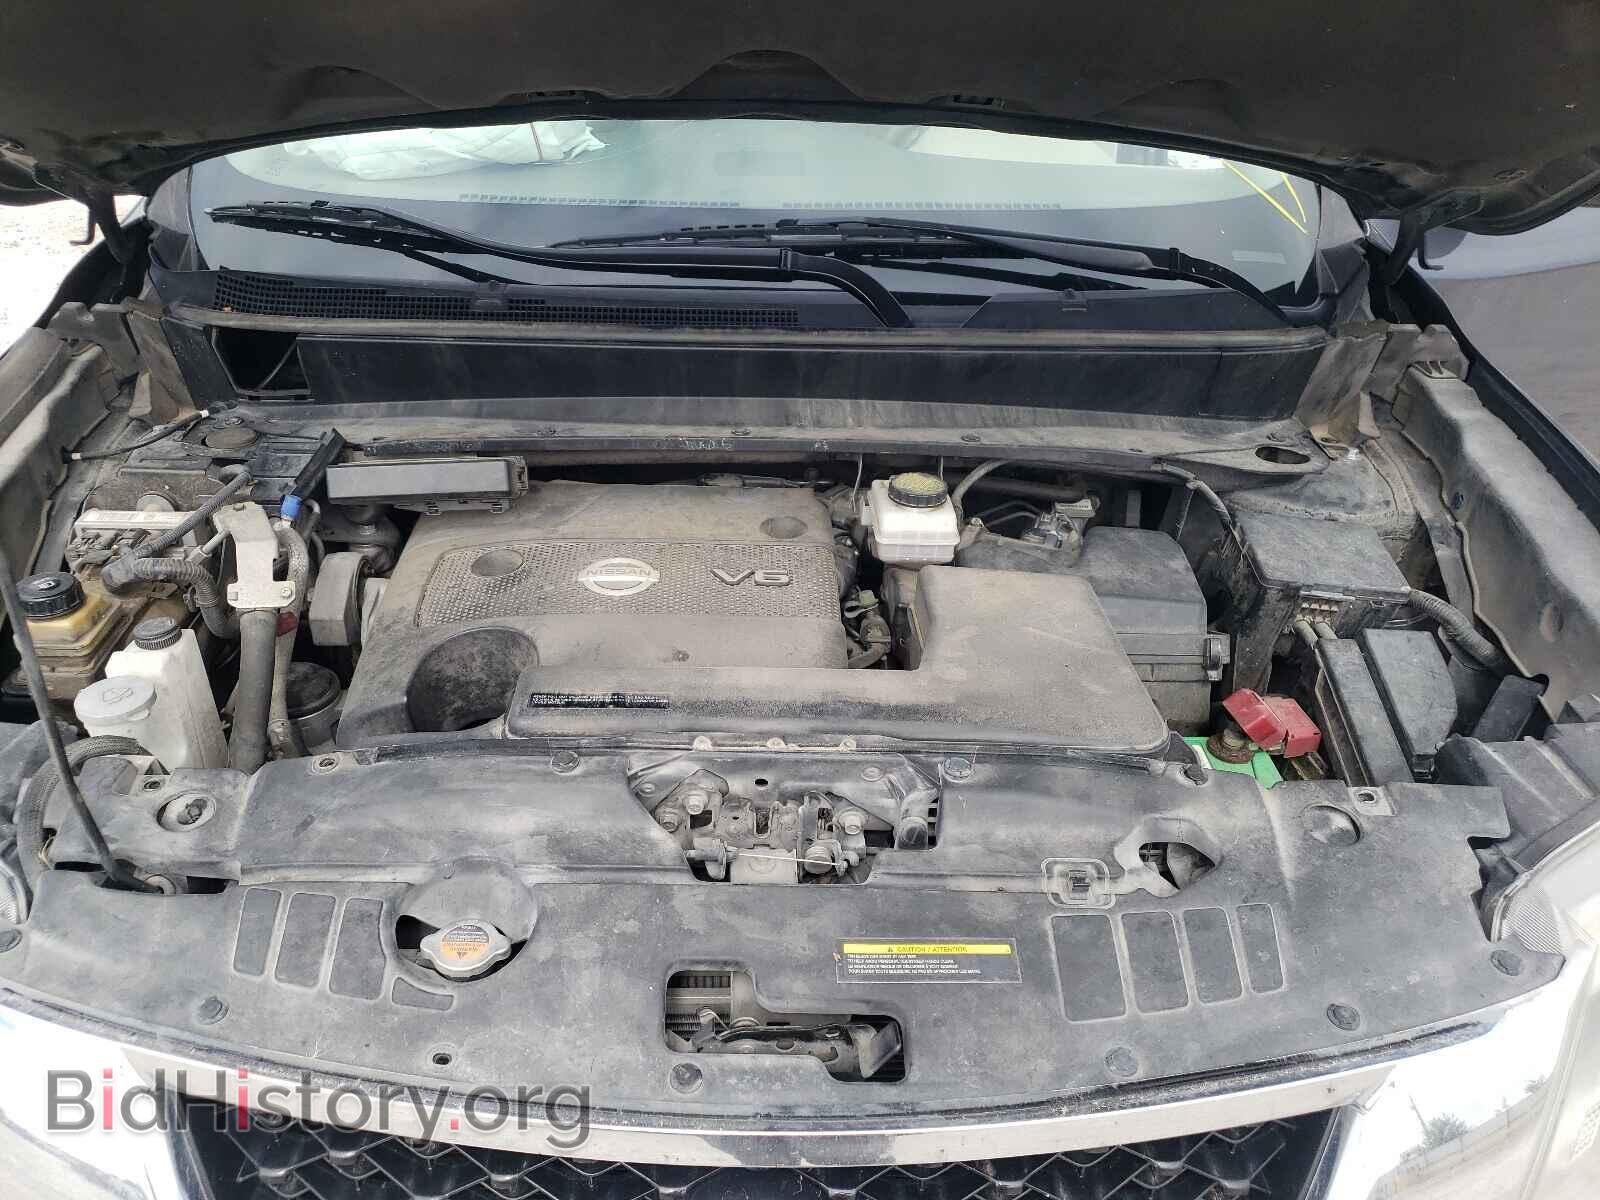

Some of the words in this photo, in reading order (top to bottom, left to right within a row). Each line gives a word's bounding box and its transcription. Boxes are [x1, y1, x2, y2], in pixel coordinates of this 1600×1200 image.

[585, 568, 651, 576] NISSAN
[710, 567, 791, 586] V6
[896, 945, 926, 953] CAUTION
[932, 945, 968, 953] ATTENTION
